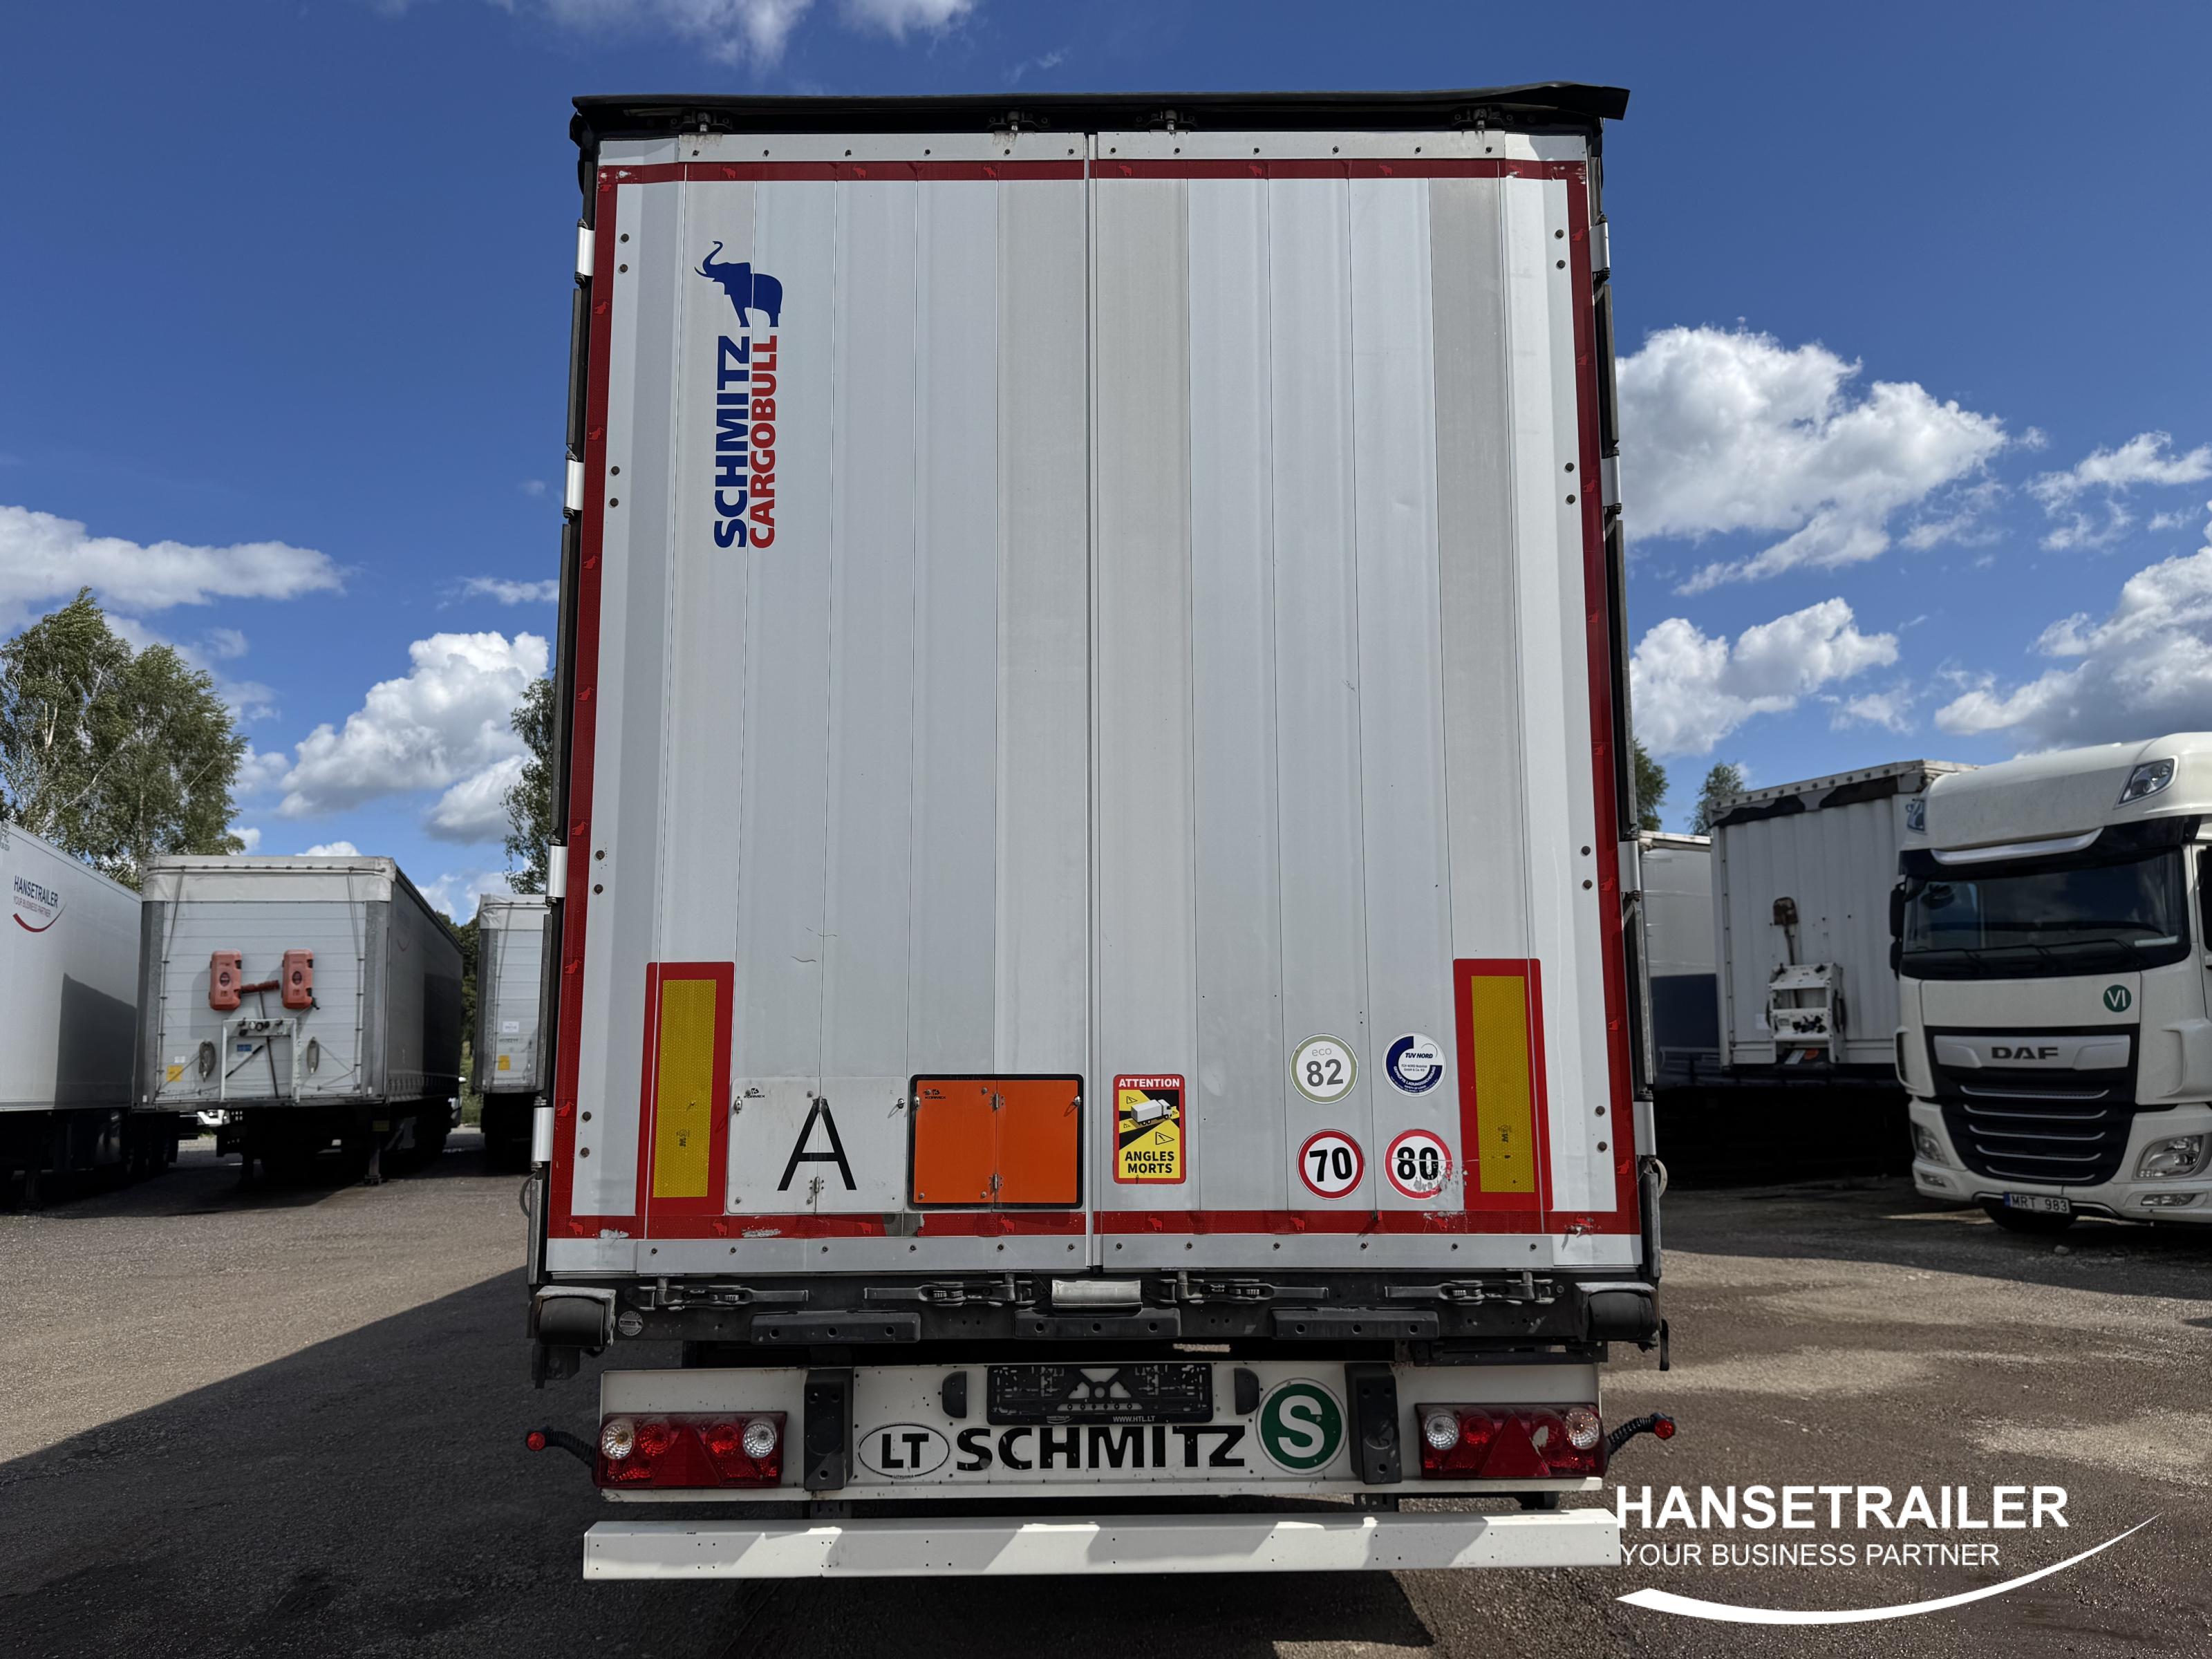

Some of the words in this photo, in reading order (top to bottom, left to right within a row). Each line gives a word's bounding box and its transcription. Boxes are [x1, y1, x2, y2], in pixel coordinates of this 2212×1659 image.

[714, 335, 750, 547] SCHMITZ
[749, 335, 778, 548] CARGOBULL
[14, 875, 58, 908] HANSETRAILER
[2107, 989, 2126, 1007] VI
[1312, 1047, 1332, 1056] eco
[1991, 1047, 2059, 1060] DAF
[1118, 1078, 1180, 1087] ATTENTION
[1306, 1059, 1344, 1087] 82
[777, 1098, 857, 1190] A
[1125, 1151, 1174, 1161] ANGLES
[1127, 1163, 1173, 1174] MORTS
[1309, 1147, 1353, 1182] 70
[1397, 1147, 1438, 1180] 80
[2012, 1196, 2036, 1208] MRT
[2045, 1199, 2067, 1212] 983
[1278, 1395, 1324, 1458] S
[882, 1433, 929, 1468] LT
[957, 1425, 1245, 1472] SCHMITZ
